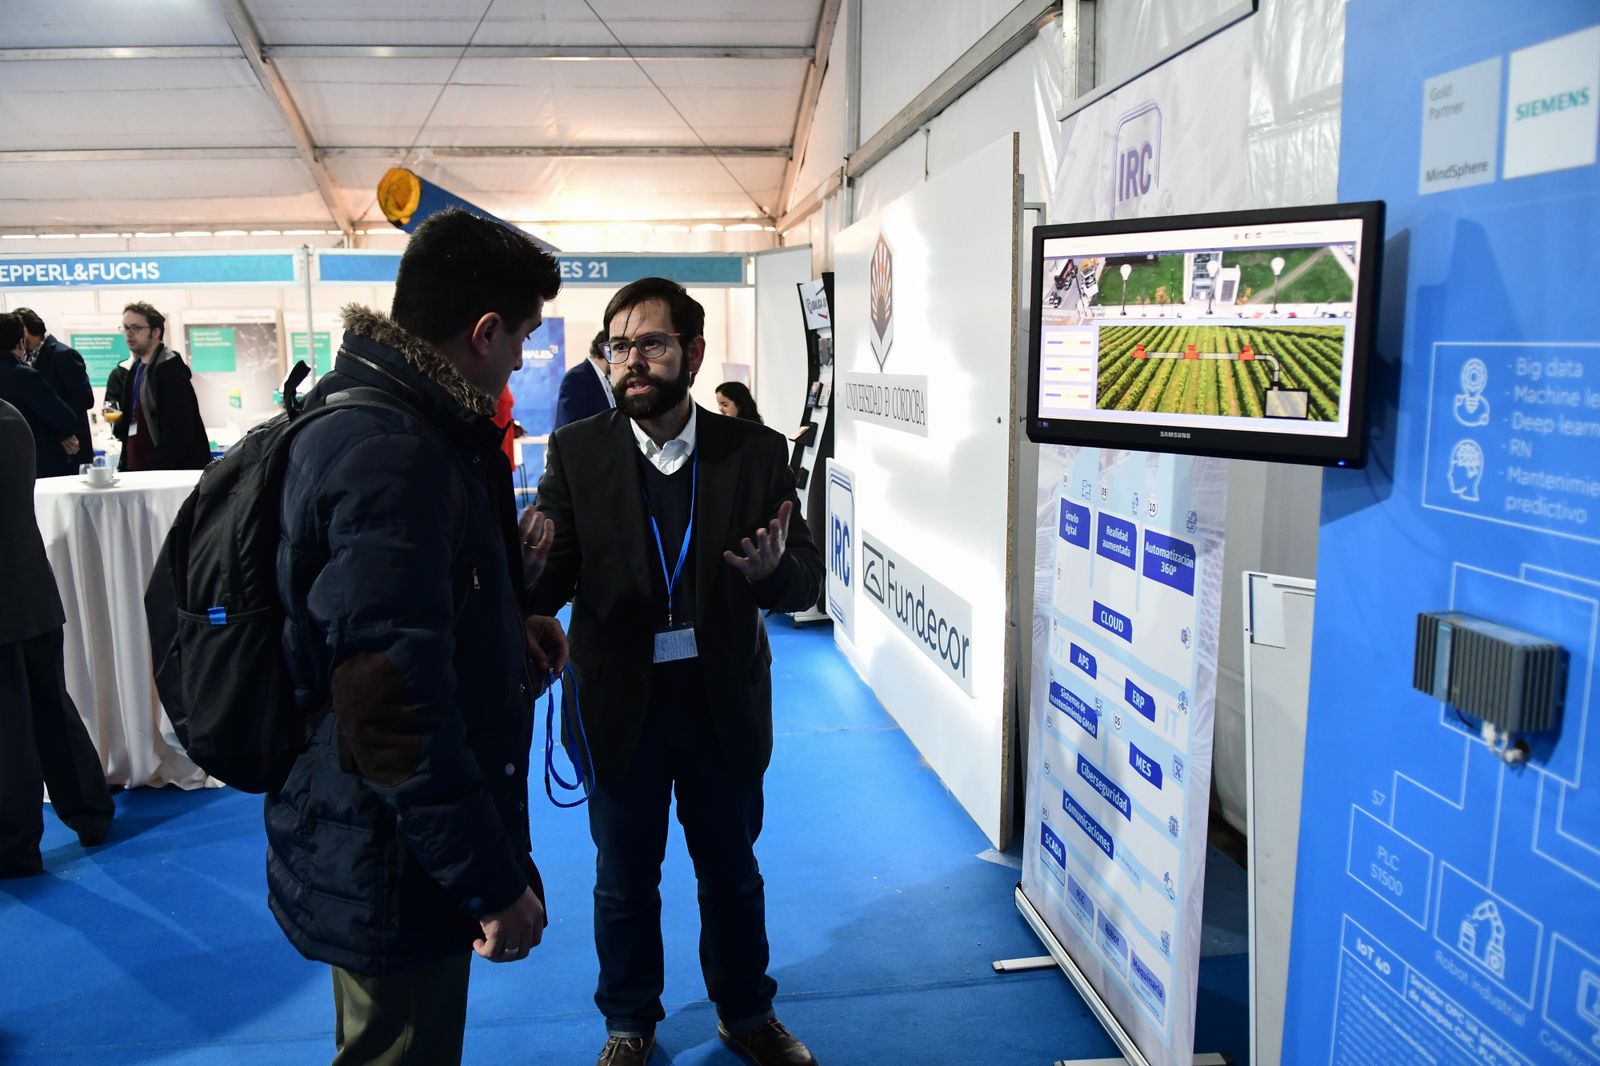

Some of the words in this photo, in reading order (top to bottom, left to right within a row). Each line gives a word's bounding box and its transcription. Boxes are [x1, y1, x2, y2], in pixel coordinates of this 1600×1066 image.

[1428, 102, 1465, 120] Partner
[1515, 87, 1590, 121] SIEMENS
[1119, 143, 1152, 202] IRC
[1426, 160, 1489, 183] MindSphere
[0, 262, 160, 282] EPPERL&FUCHS
[587, 262, 608, 278] 21
[1516, 356, 1541, 380] Big
[1547, 357, 1584, 378] data
[1513, 385, 1581, 407] Machine
[1160, 430, 1190, 438] SAMSUNG
[1512, 411, 1555, 436] Deep
[1509, 438, 1532, 458] RN
[1505, 495, 1588, 524] predictivo
[1105, 525, 1128, 542] Realidad
[830, 515, 850, 587] IRC
[1102, 540, 1131, 557] aumentada
[1144, 541, 1194, 569] Automatización
[887, 559, 969, 679] Fundecor
[1100, 610, 1124, 633] CLOUD
[1077, 652, 1089, 670] APS
[1132, 689, 1145, 709] ERP
[1135, 754, 1152, 777] MES
[1081, 762, 1127, 813] Ciberseguridad
[1371, 789, 1386, 807] S7
[1064, 797, 1110, 852] Comunicaciones
[1045, 833, 1062, 861] SCADA
[1377, 845, 1399, 871] PLC
[1370, 863, 1403, 897] S1500
[1132, 957, 1163, 999] Maquinaria
[1435, 949, 1469, 985] Robot
